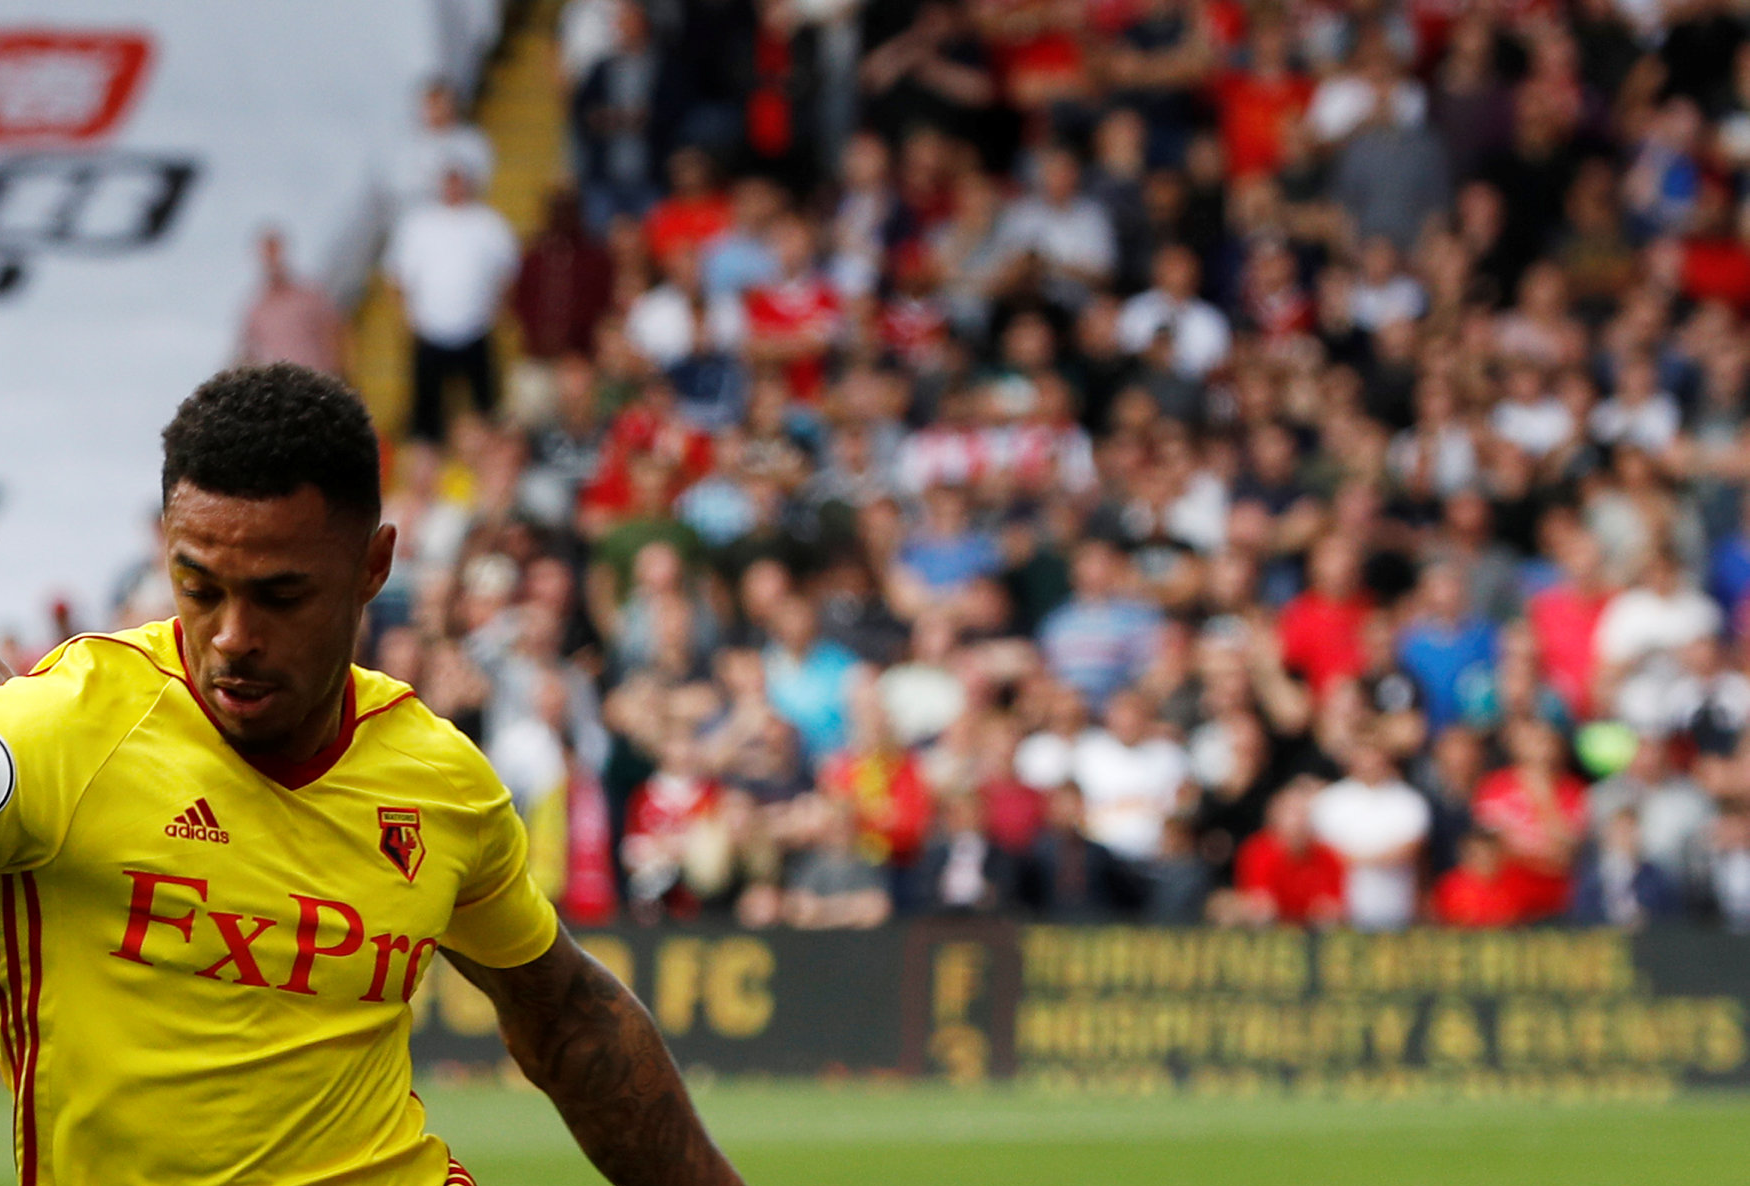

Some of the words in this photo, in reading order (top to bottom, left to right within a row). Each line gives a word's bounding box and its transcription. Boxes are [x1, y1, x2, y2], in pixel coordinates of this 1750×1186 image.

[164, 823, 230, 845] adidas
[653, 932, 777, 1040] FC
[1496, 998, 1744, 1074] EVENTS
